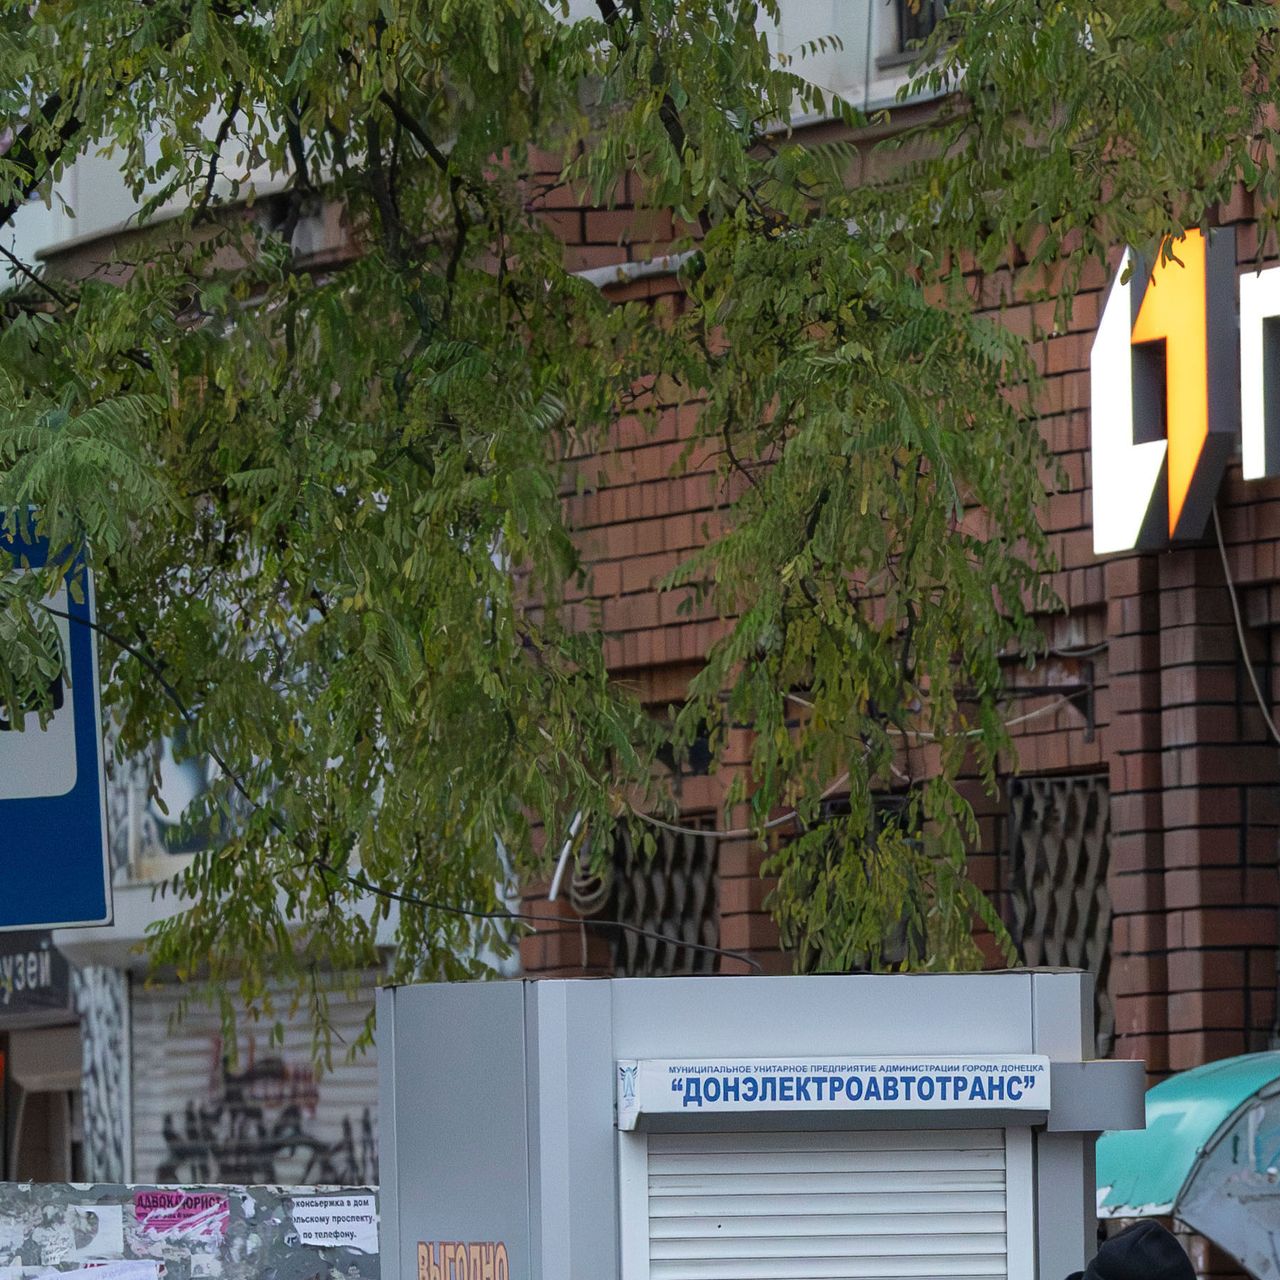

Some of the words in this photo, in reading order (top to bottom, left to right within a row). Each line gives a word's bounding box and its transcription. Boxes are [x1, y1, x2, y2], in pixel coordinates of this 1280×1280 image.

[668, 1065, 751, 1074] МУНИЦИПАЛЬНОЕ
[753, 1065, 808, 1073] УНИТАРНОЕ
[810, 1064, 877, 1073] ПРЕДПРИЯТИЕ
[878, 1064, 960, 1073] АДМИНИСТРАЦИИ
[962, 1064, 998, 1073] ГОРОДА
[1000, 1064, 1044, 1073] ДОНЕЦКА
[295, 1200, 345, 1209] консьержка
[353, 1199, 370, 1208] дом
[303, 1231, 313, 1239] по
